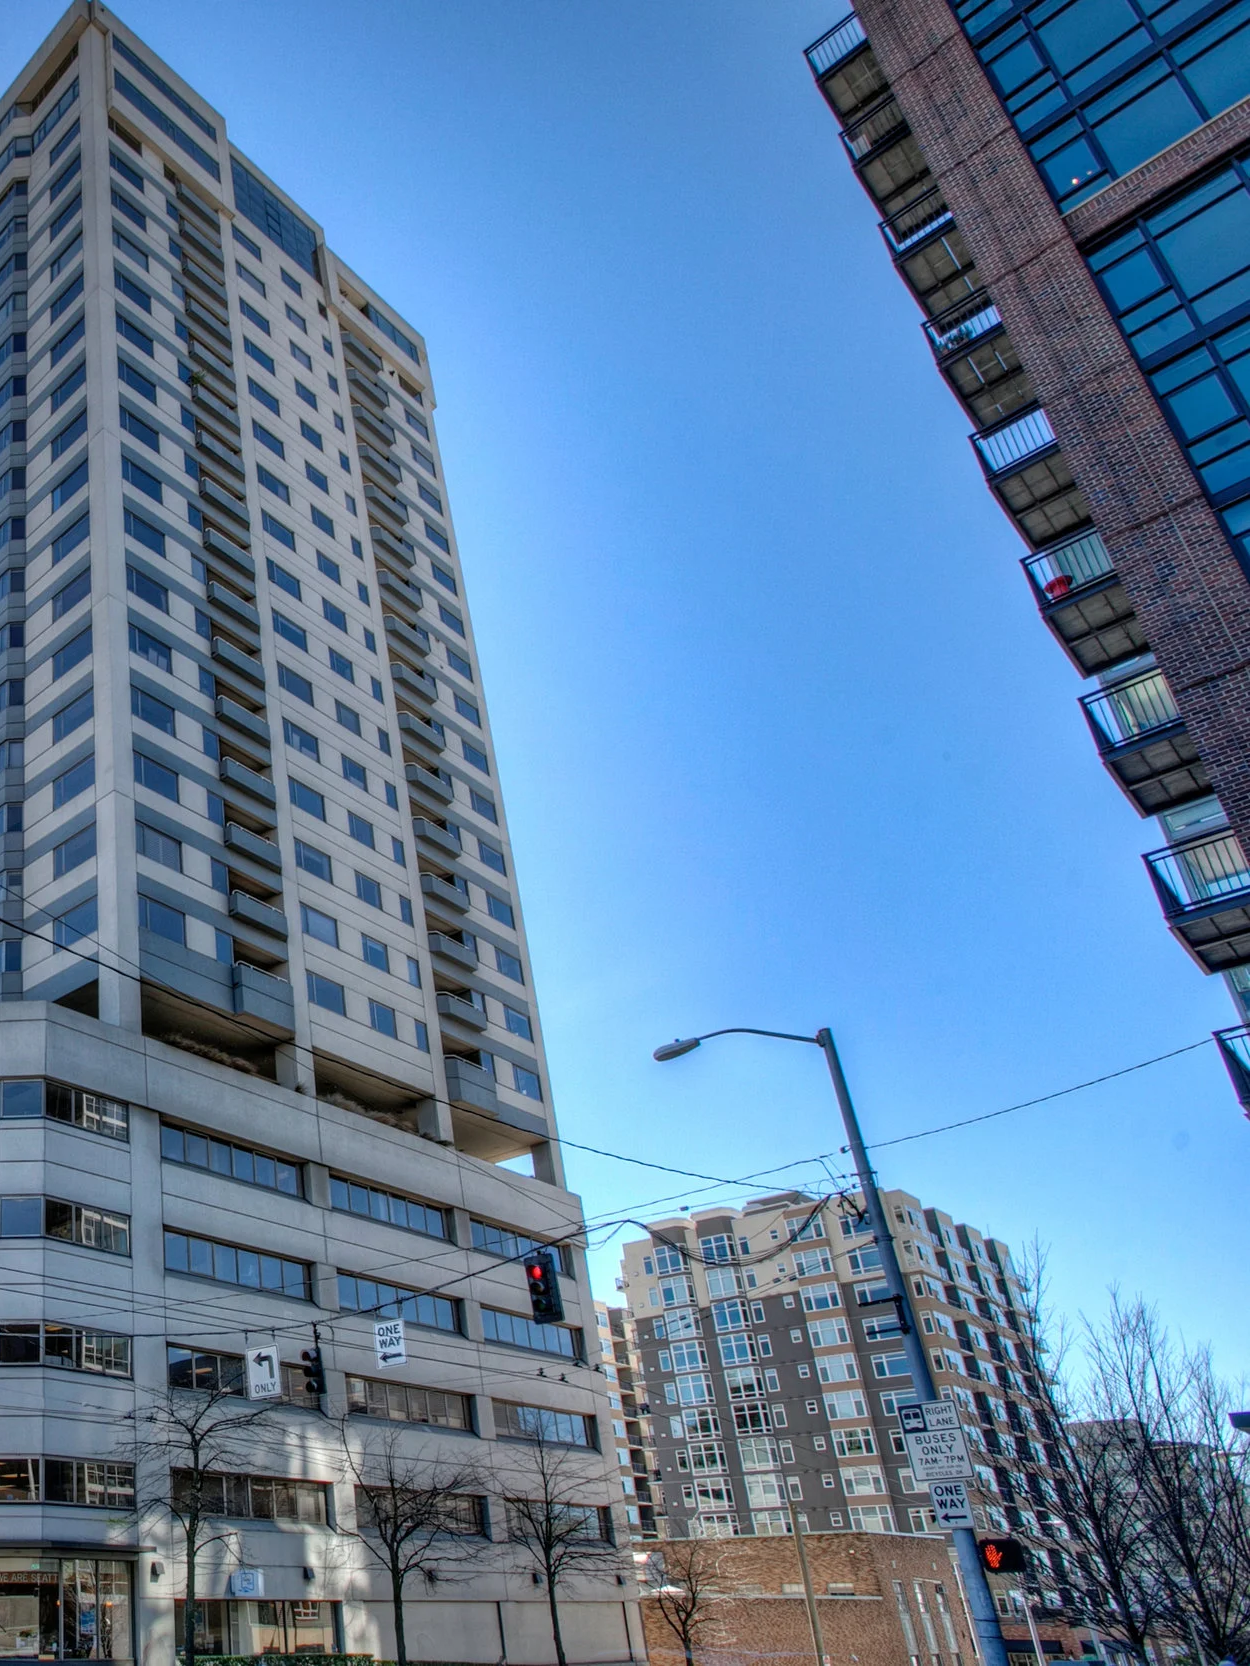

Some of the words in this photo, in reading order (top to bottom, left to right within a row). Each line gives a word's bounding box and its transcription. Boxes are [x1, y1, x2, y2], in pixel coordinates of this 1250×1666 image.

[377, 1323, 400, 1337] ONE
[378, 1336, 401, 1349] WAY
[254, 1381, 277, 1394] ONLY
[924, 1405, 953, 1416] RIGHT
[929, 1416, 956, 1427] LANE
[914, 1432, 957, 1445] BUSES
[921, 1444, 954, 1456] ONLY
[944, 1454, 965, 1464] 7PM
[934, 1484, 964, 1497] ONE
[936, 1498, 966, 1510] WAY
[11, 1573, 29, 1583] ARE
